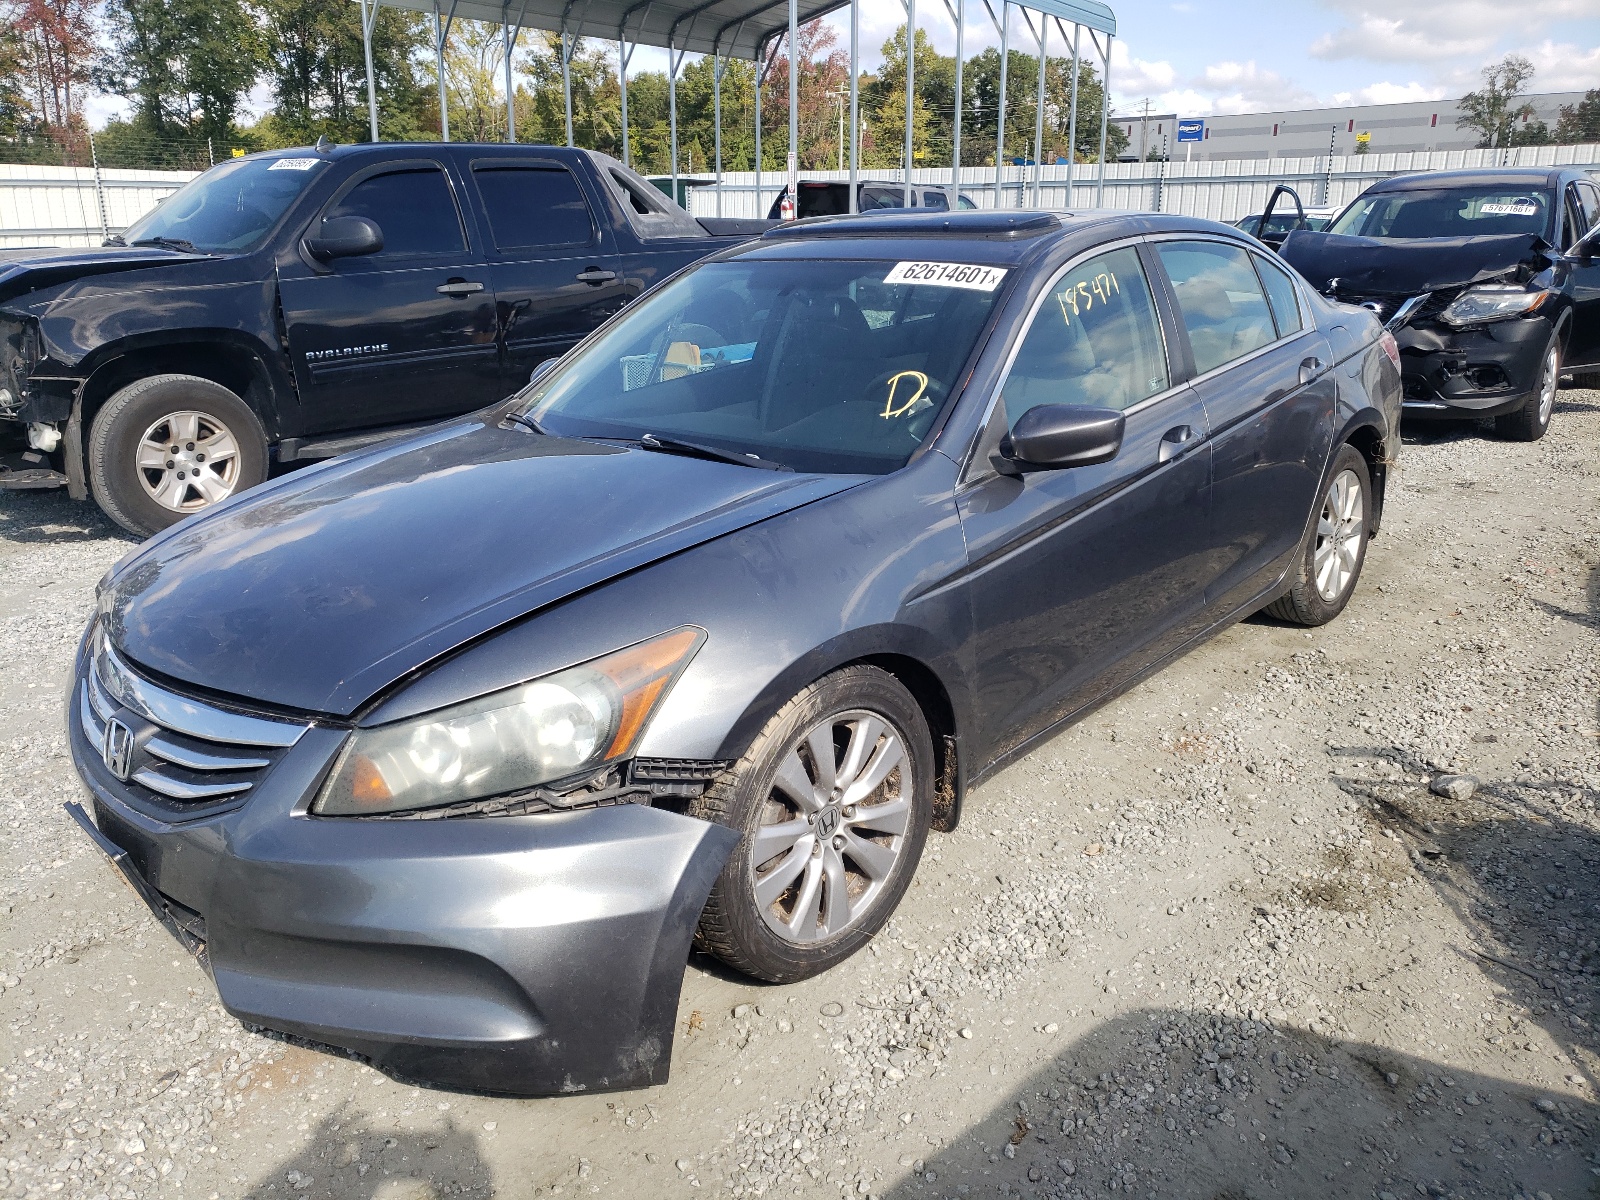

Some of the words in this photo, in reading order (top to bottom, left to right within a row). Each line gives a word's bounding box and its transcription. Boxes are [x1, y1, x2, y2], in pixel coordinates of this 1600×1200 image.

[903, 263, 992, 285] 62614601
[305, 343, 389, 360] AVALANCHE
[879, 370, 929, 420] D
